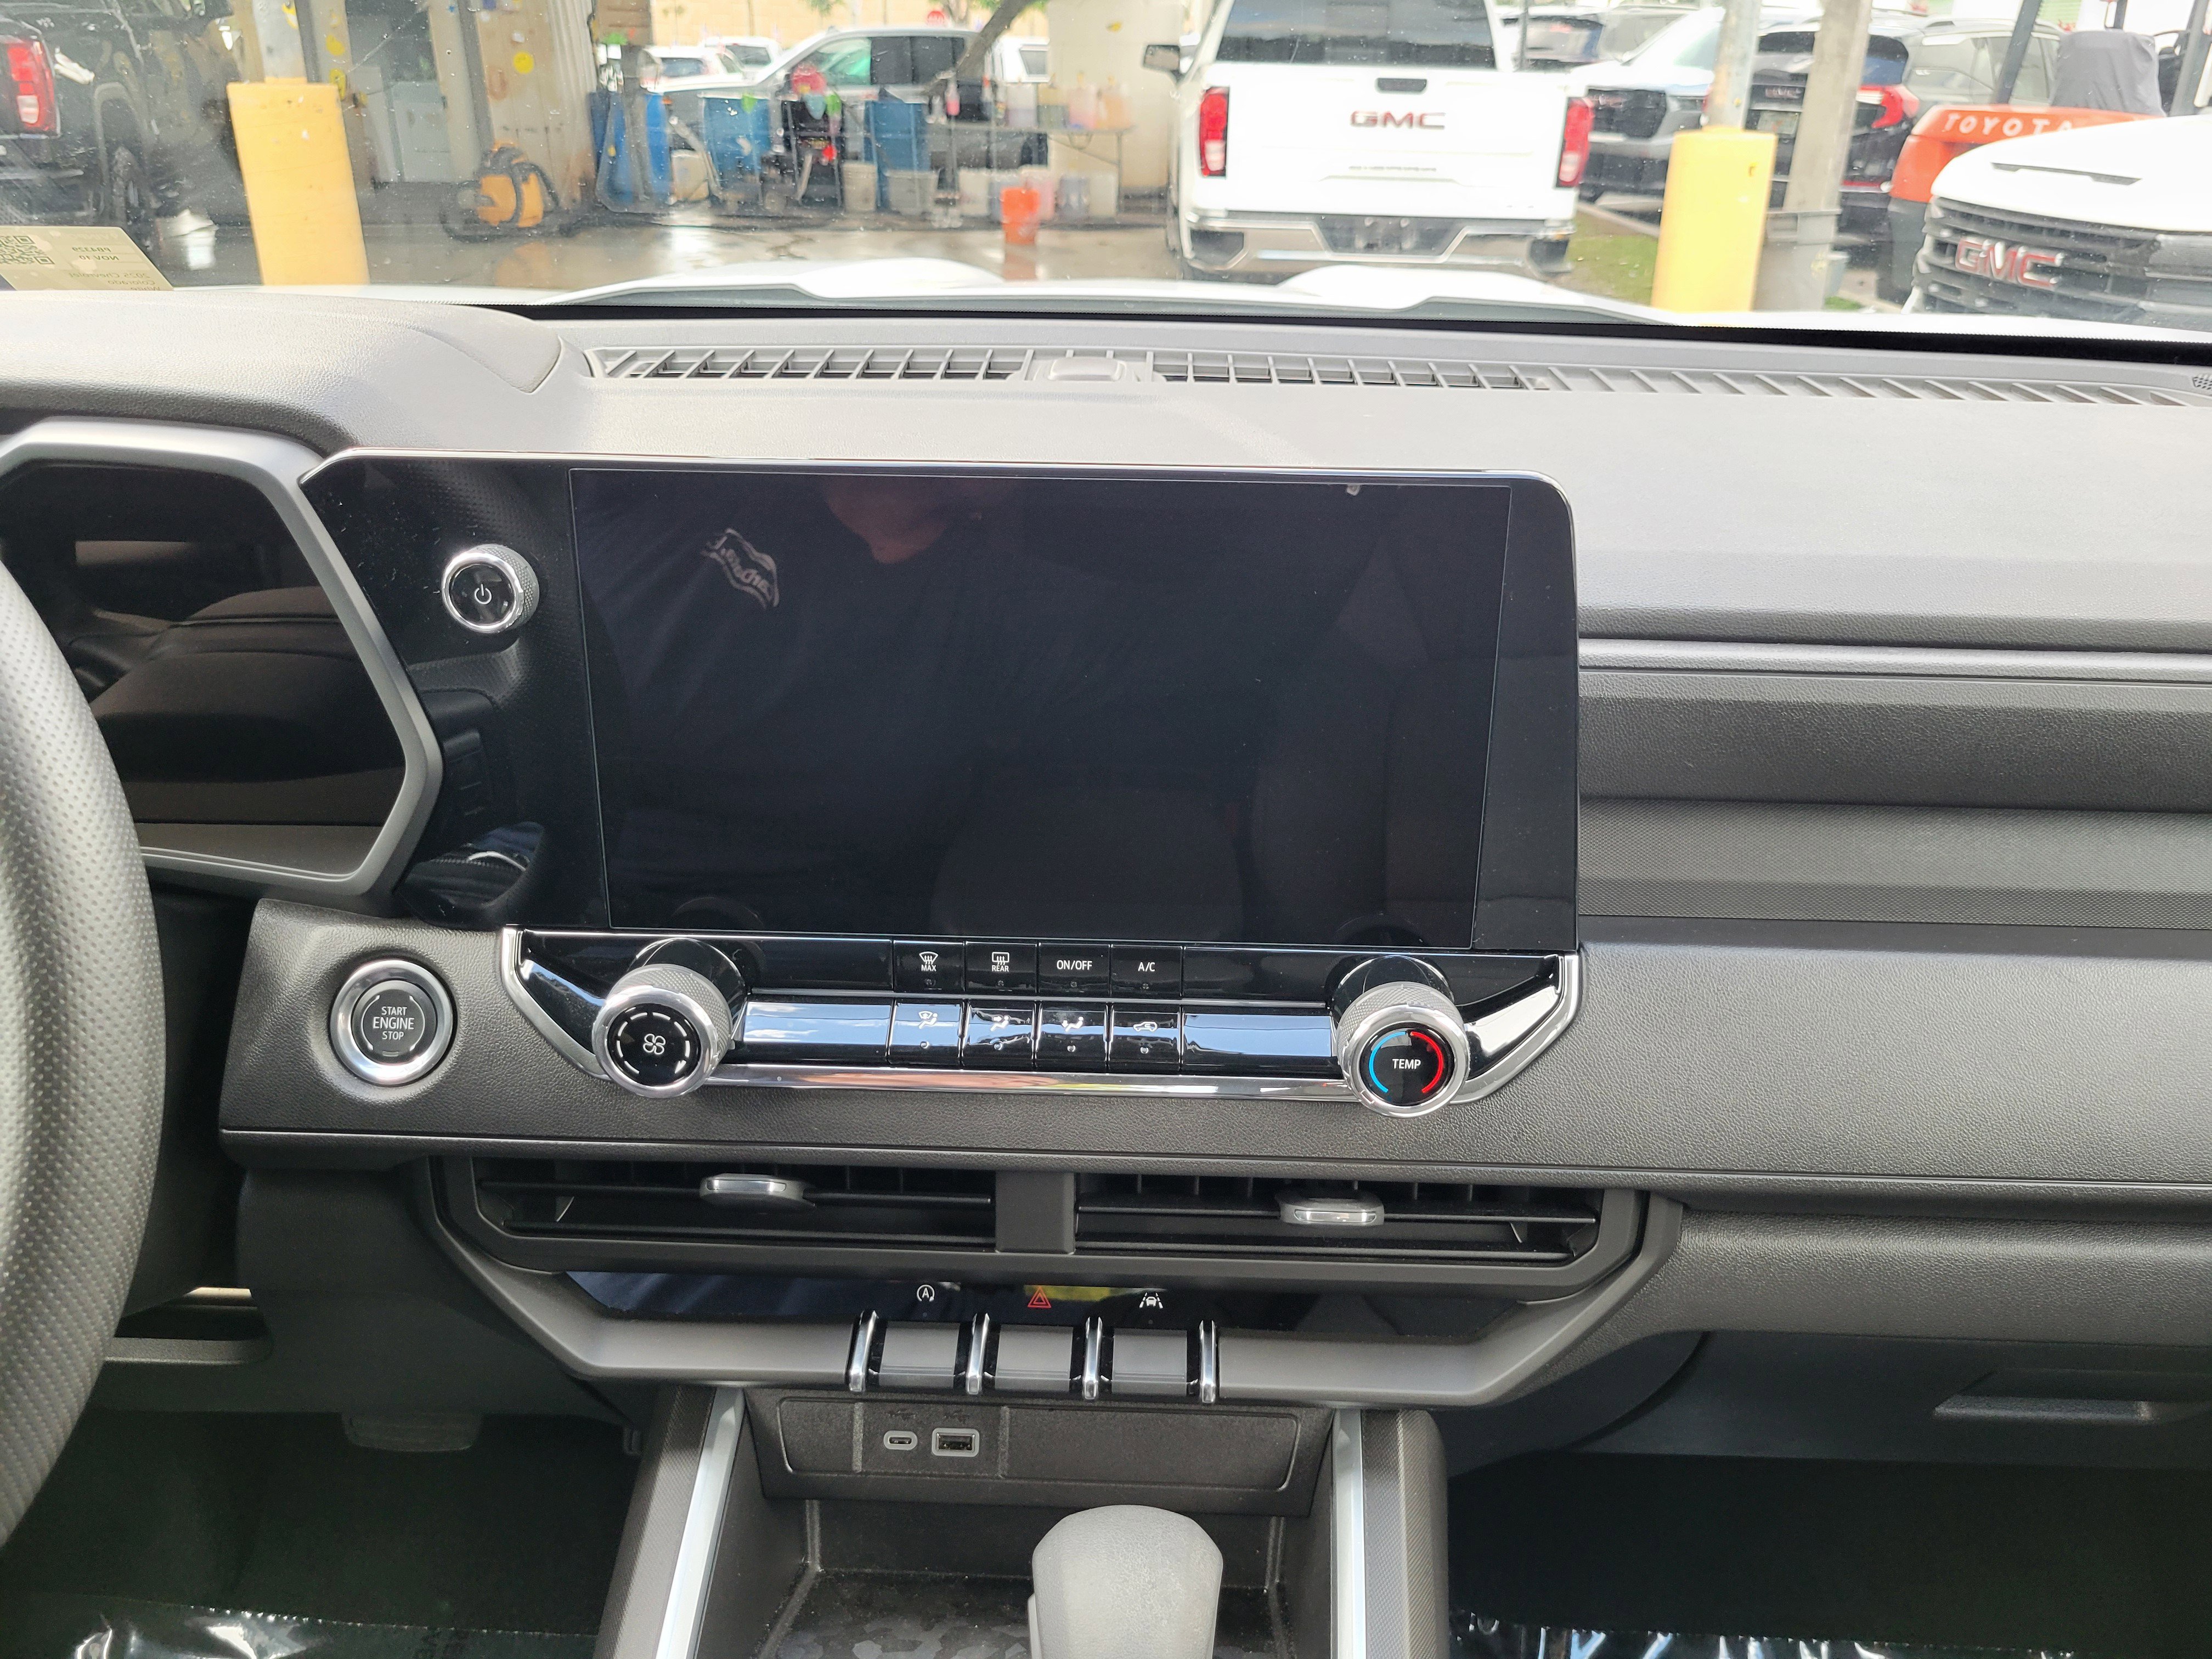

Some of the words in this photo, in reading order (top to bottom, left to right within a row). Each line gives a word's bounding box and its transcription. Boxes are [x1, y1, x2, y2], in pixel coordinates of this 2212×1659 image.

[1350, 110, 1447, 130] GMC
[1943, 112, 2074, 137] TOYOTA
[1955, 236, 2067, 291] GMC
[921, 964, 937, 972] MAX
[1057, 960, 1093, 970] ON/OFF
[1138, 962, 1156, 972] A/C
[381, 1006, 408, 1015] START
[373, 1016, 415, 1030] ENGINE
[382, 1031, 404, 1040] STOP
[1392, 1058, 1421, 1070] TEMP
[922, 1287, 930, 1298] A
